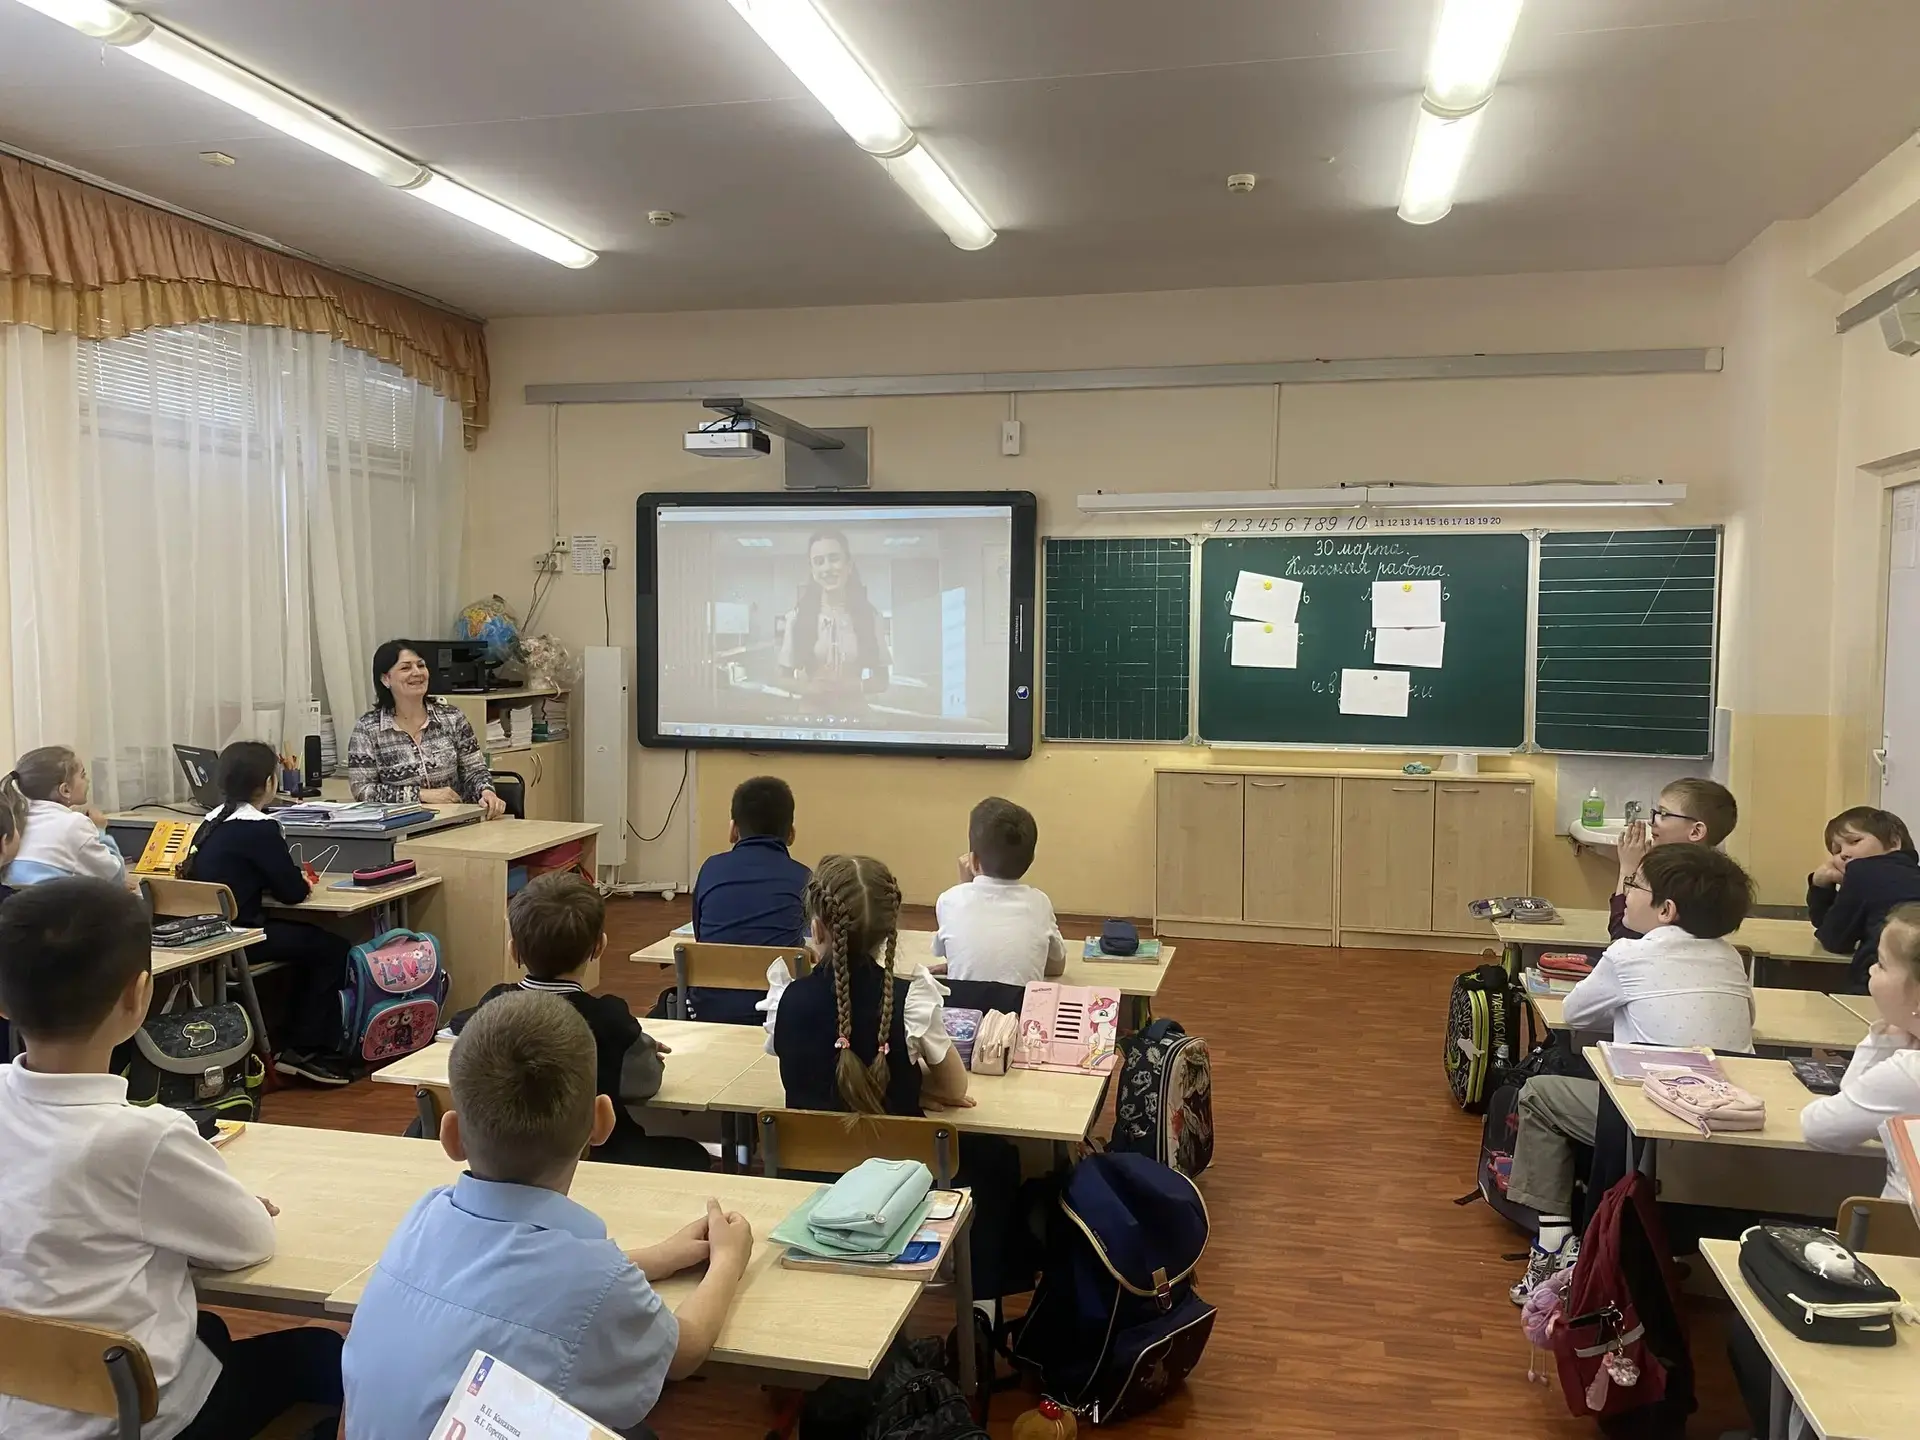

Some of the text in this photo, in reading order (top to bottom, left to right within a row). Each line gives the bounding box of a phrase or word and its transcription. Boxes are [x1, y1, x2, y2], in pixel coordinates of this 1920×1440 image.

[1347, 515, 1367, 530] 10
[1375, 519, 1384, 527] 11
[1387, 519, 1397, 527] 12
[1400, 518, 1410, 526] 13
[1413, 518, 1423, 526] 14
[1426, 517, 1436, 525] 15
[1439, 517, 1449, 525] 16
[1452, 517, 1462, 525] 17
[1465, 517, 1475, 525] 18
[1478, 517, 1488, 525] 19
[1490, 517, 1501, 525] 20
[1314, 539, 1334, 556] 30
[1285, 555, 1371, 576] Классная
[493, 1413, 521, 1437] Канакина
